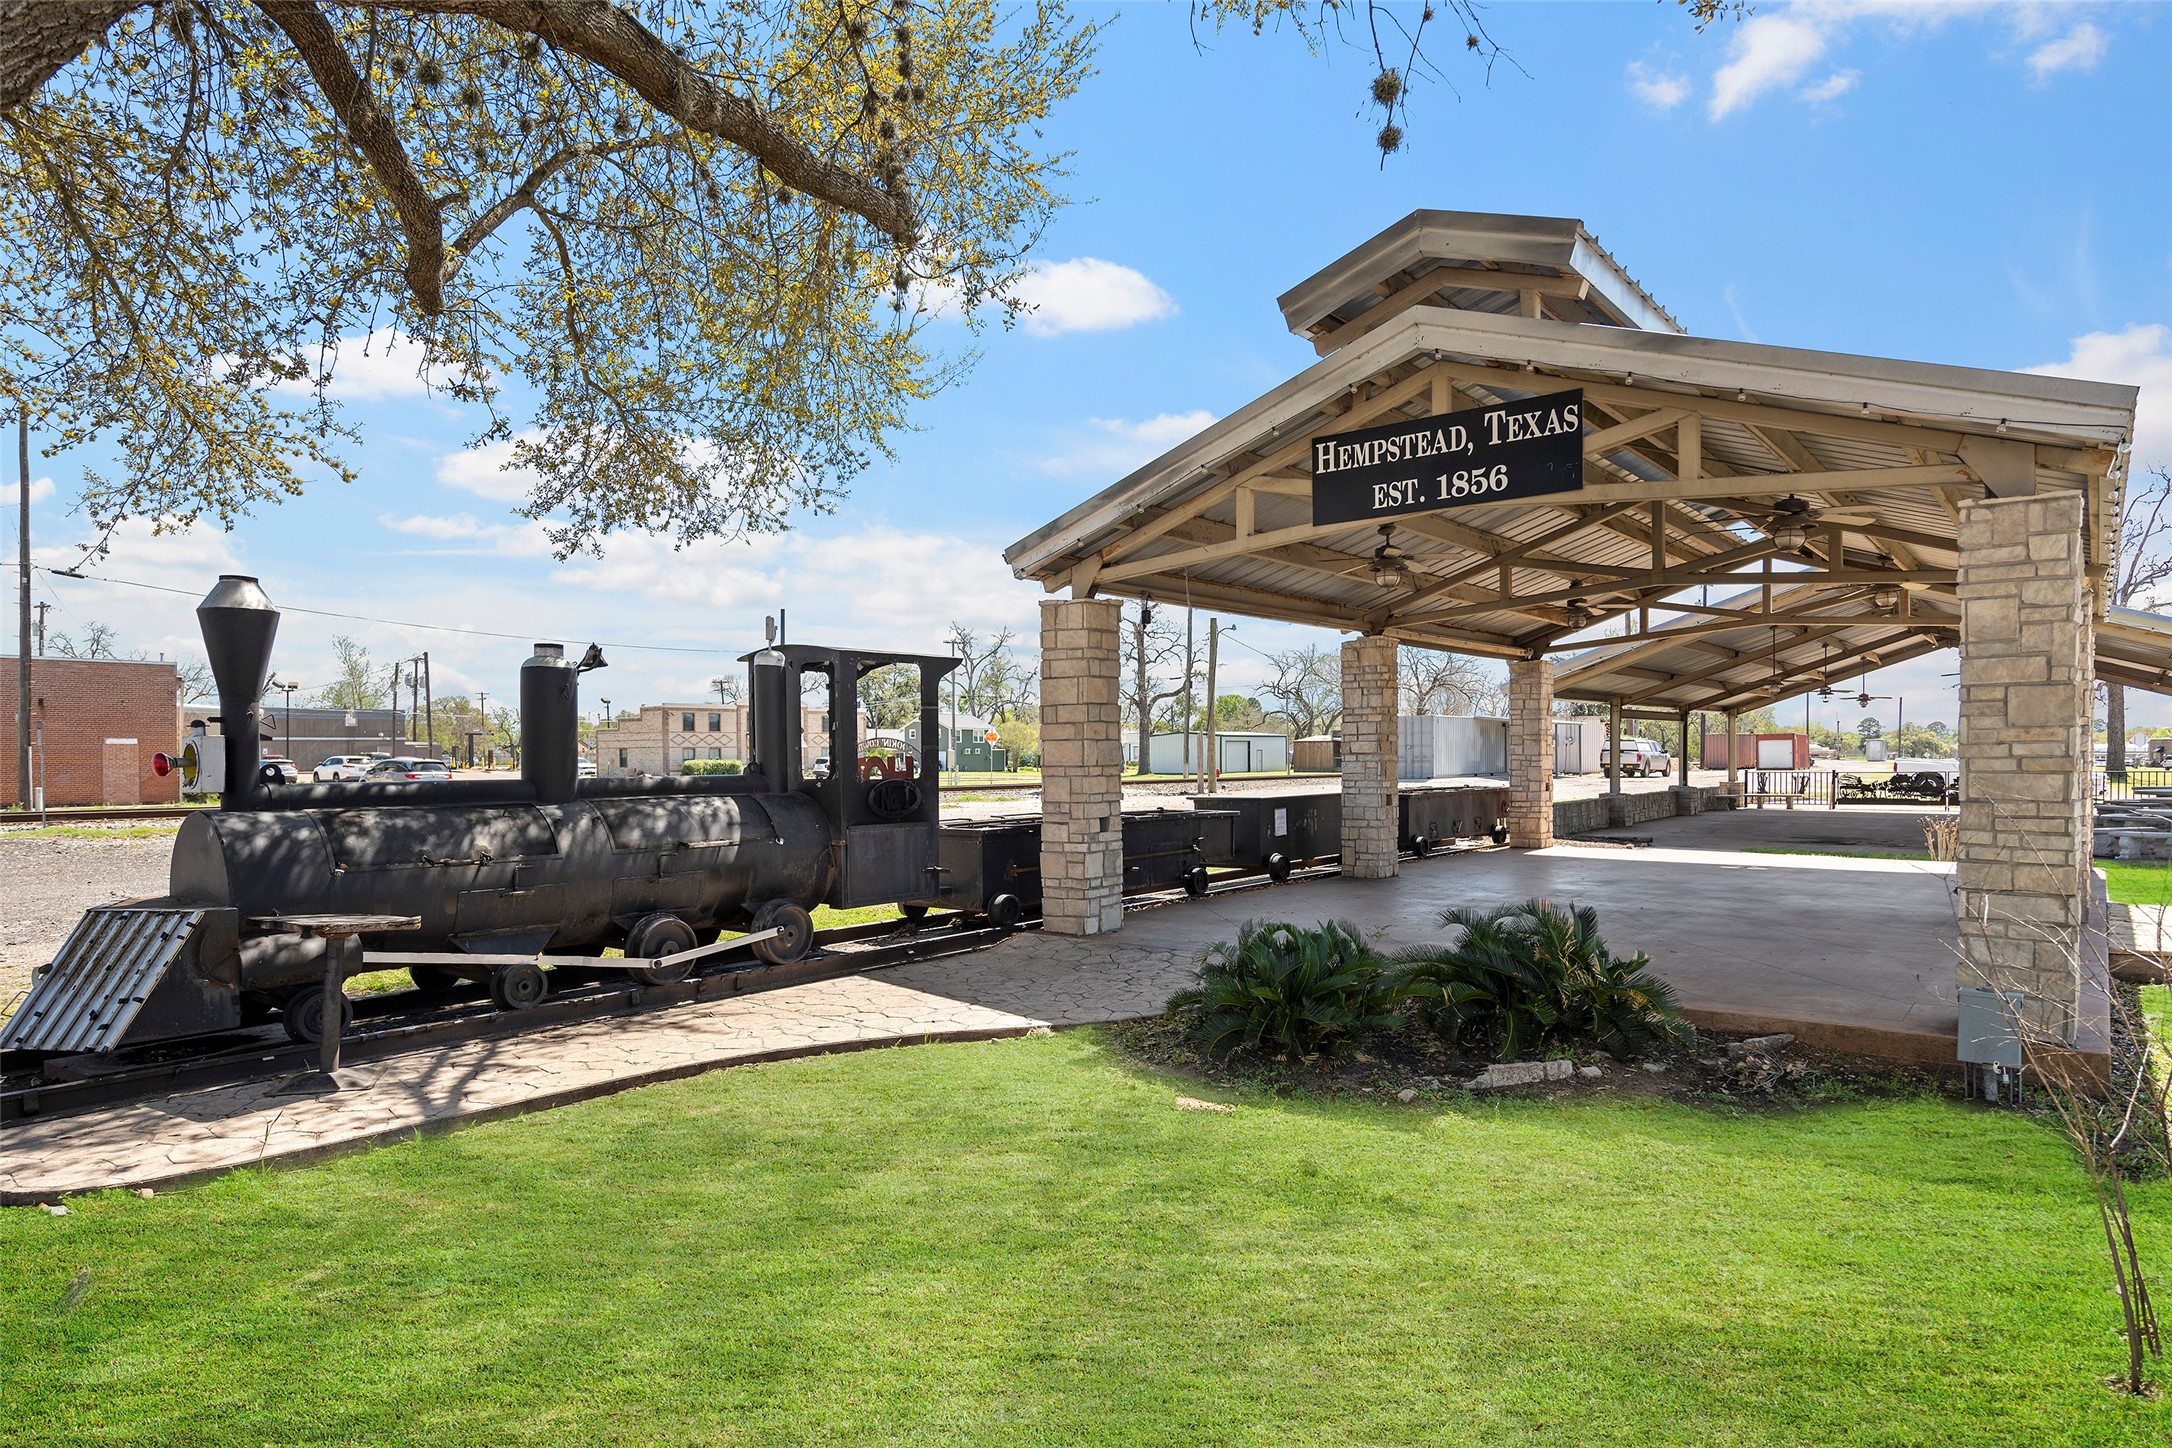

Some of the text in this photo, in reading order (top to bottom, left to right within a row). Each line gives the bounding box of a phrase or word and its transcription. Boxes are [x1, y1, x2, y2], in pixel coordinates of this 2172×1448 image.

[1316, 404, 1579, 474] HEMPSTEAD, TEXAS
[1372, 464, 1509, 510] EST. 1856
